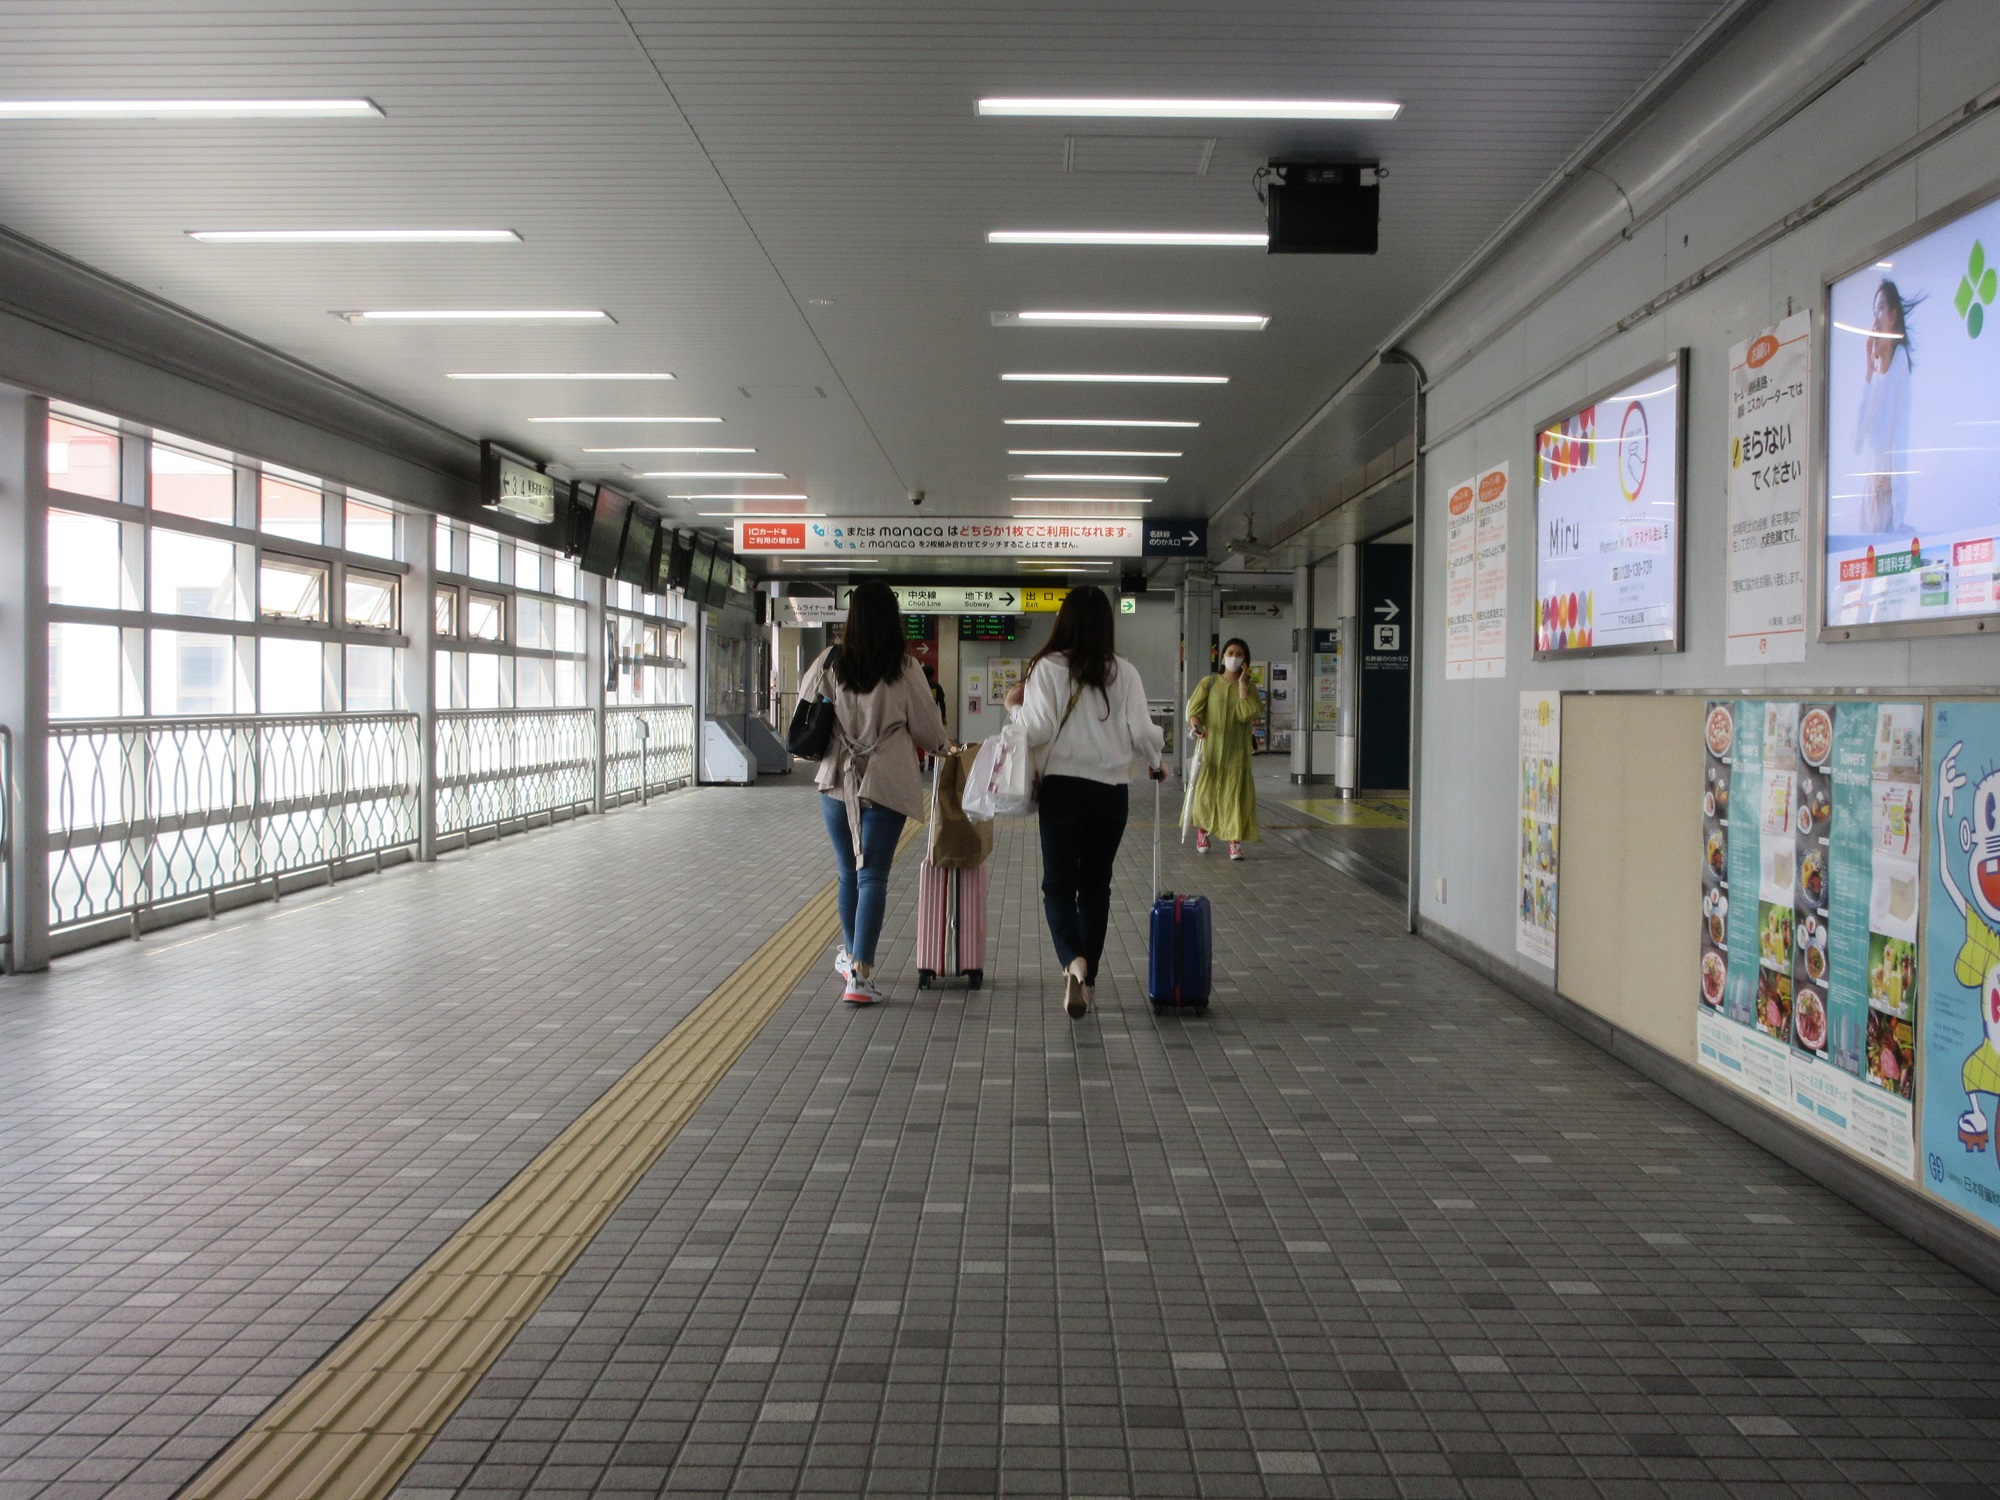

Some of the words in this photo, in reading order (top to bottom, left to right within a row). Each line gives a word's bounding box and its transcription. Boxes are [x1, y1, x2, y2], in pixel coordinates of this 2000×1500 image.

[1743, 424, 1792, 463] 走らない
[1752, 460, 1801, 491] でください
[748, 527, 787, 536] ICカードを
[847, 527, 875, 537] または
[879, 525, 943, 537] manaca
[1149, 530, 1171, 538] 名鉄線
[748, 537, 800, 545] ご利用の場合は
[1549, 518, 1580, 557] Miru
[859, 540, 866, 548] と
[868, 540, 916, 548] manaca
[918, 540, 1080, 549] を2枚組み合わせてタッチすることはできません。
[1149, 539, 1181, 547] のりかえ口
[1957, 543, 1989, 562] 看護学部
[908, 590, 937, 600] 中央線
[964, 591, 994, 600] 地下鉄
